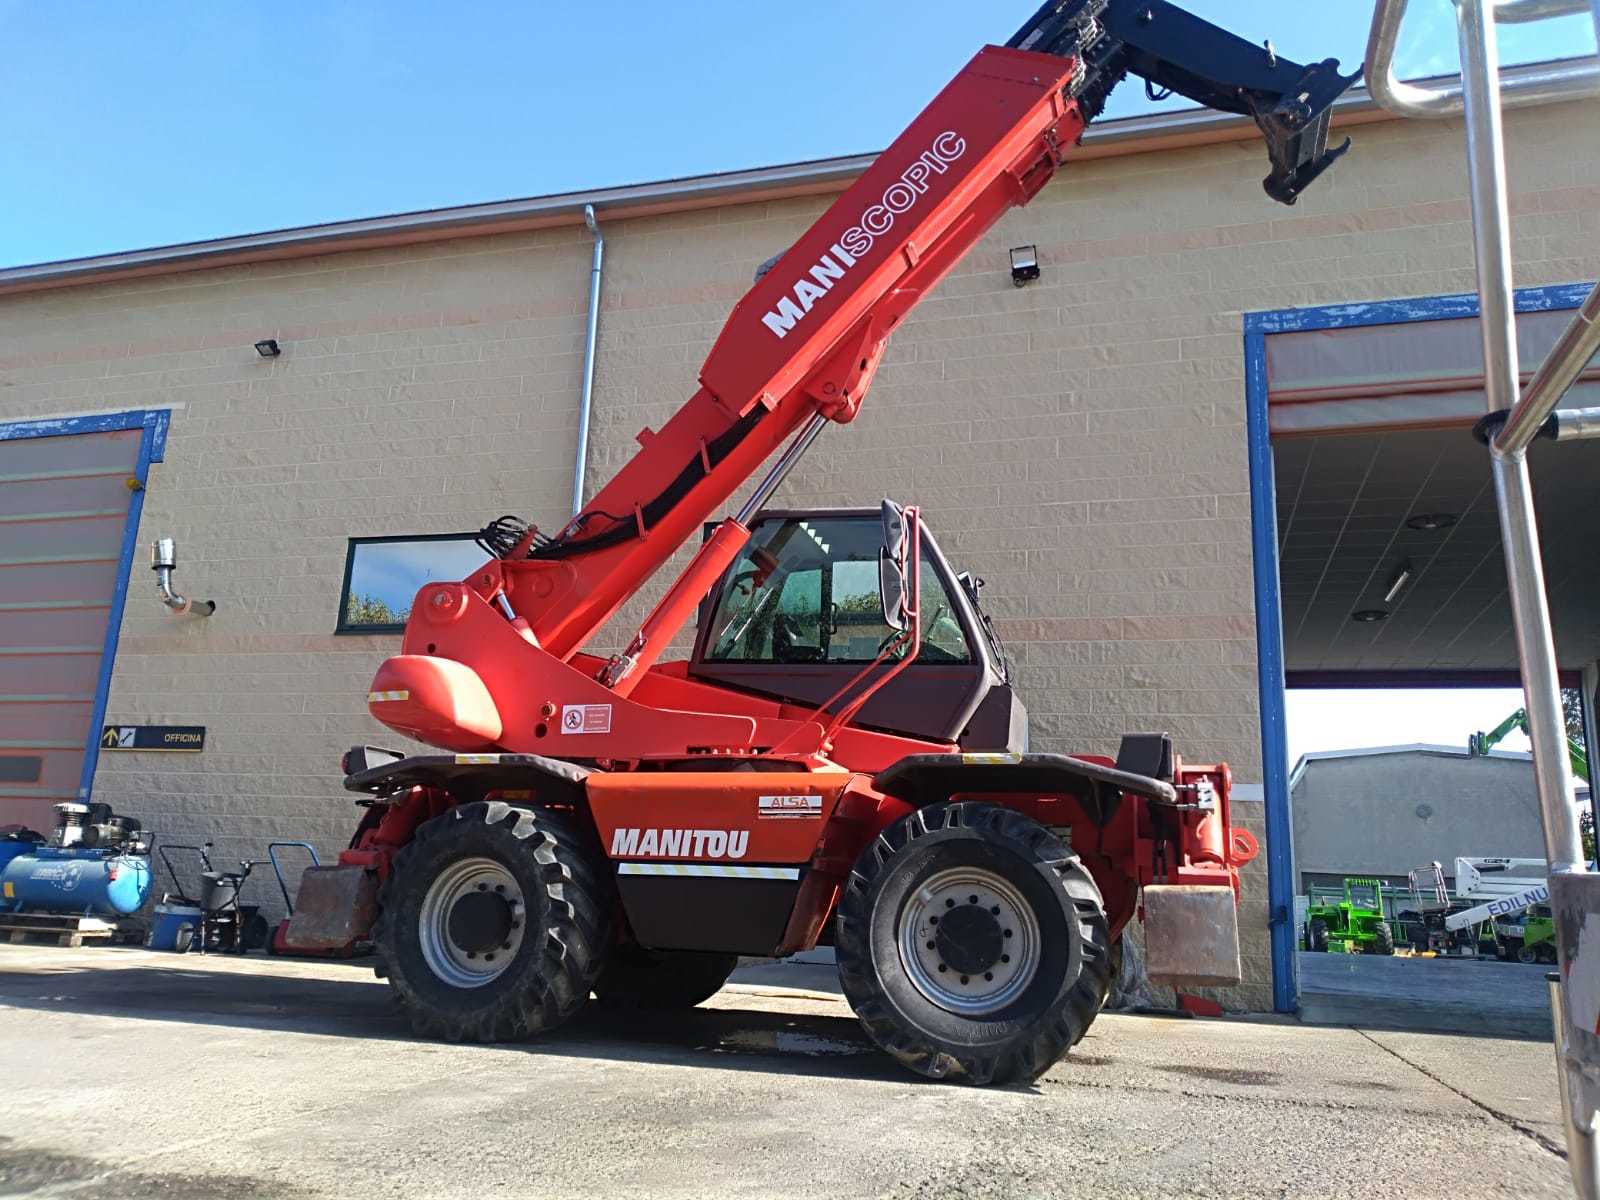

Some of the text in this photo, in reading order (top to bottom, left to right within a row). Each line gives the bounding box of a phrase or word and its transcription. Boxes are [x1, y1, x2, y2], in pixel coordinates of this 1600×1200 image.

[761, 132, 966, 339] MANISCOPIC
[164, 733, 201, 743] OFFICINA
[770, 797, 809, 808] ALSA
[611, 828, 750, 859] MANITOU
